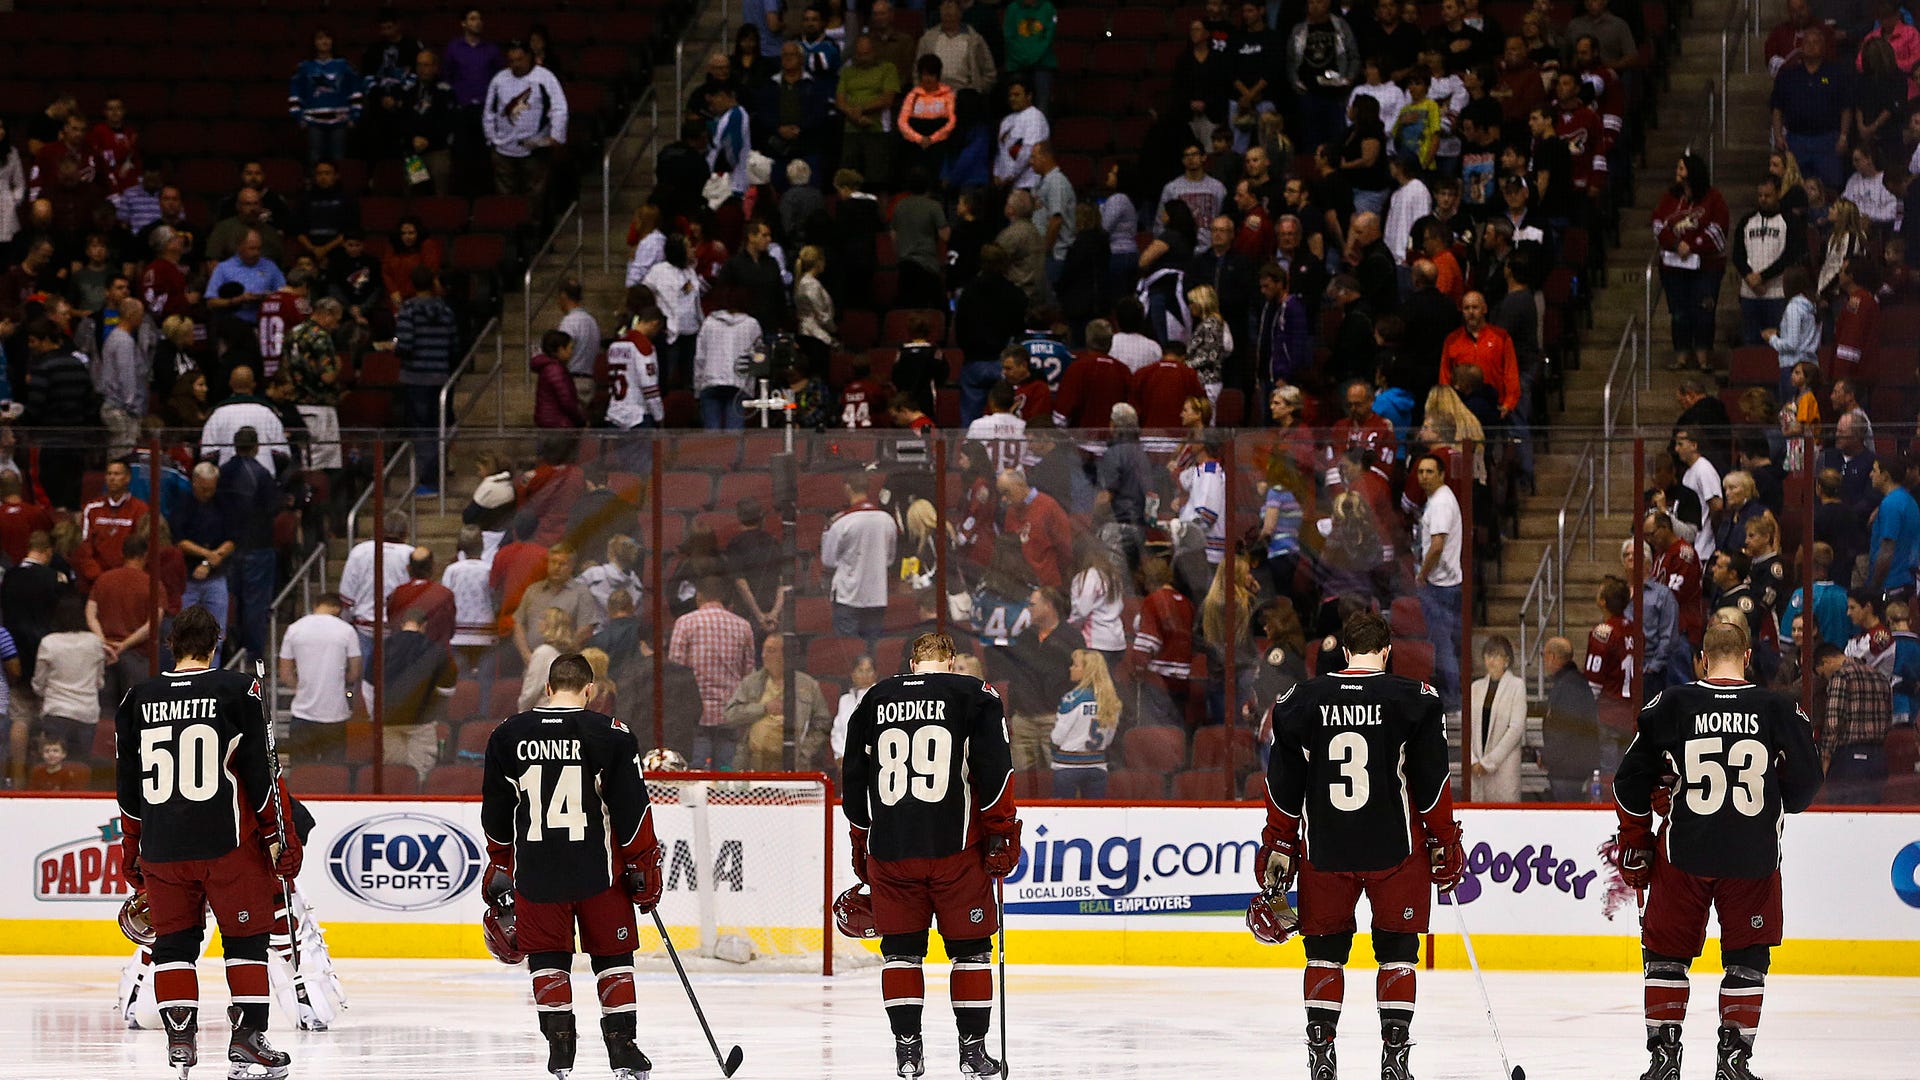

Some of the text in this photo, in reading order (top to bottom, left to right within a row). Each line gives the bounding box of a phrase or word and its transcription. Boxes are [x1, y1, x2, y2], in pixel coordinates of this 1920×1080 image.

[141, 698, 217, 724] VERMETTE
[877, 700, 946, 725] BOEDKER
[1319, 704, 1383, 727] YANDLE
[1695, 712, 1760, 735] MORRIS
[516, 739, 582, 761] CONNER
[140, 723, 219, 805] 50
[877, 725, 952, 806] 89
[1328, 731, 1370, 812] 3
[1684, 736, 1769, 817] 53
[518, 764, 588, 841] 14
[362, 833, 448, 872] FOX
[41, 844, 127, 894] PAPA
[361, 874, 450, 890] SPORTS
[1019, 886, 1095, 899] LOCAL JOBS,
[1079, 896, 1192, 913] REAL EMPLOYERS
